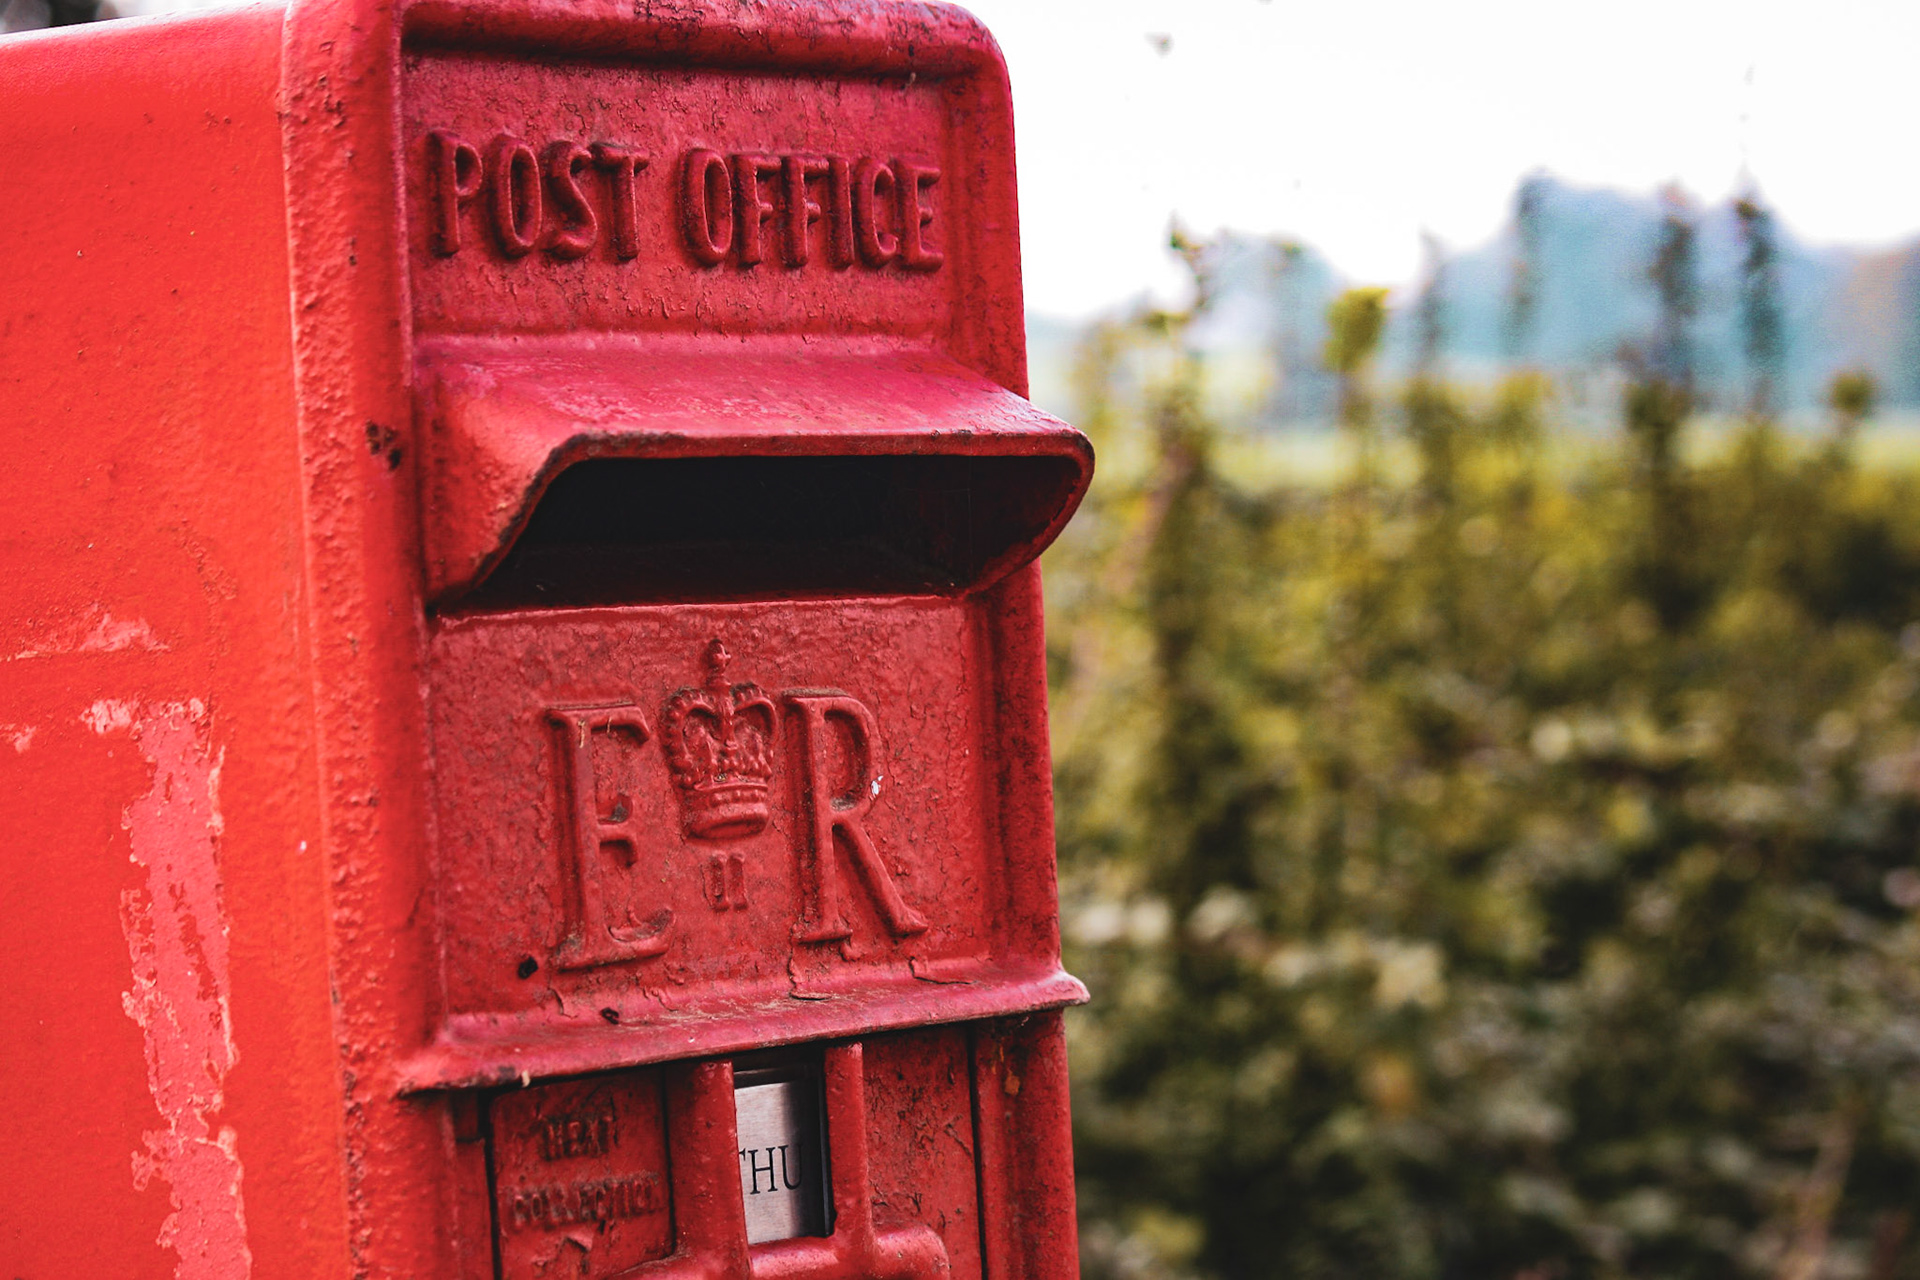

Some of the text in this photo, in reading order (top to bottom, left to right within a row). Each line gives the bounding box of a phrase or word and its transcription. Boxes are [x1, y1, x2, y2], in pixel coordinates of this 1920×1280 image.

[424, 128, 945, 272] POST OFFICE
[542, 687, 929, 973] E R
